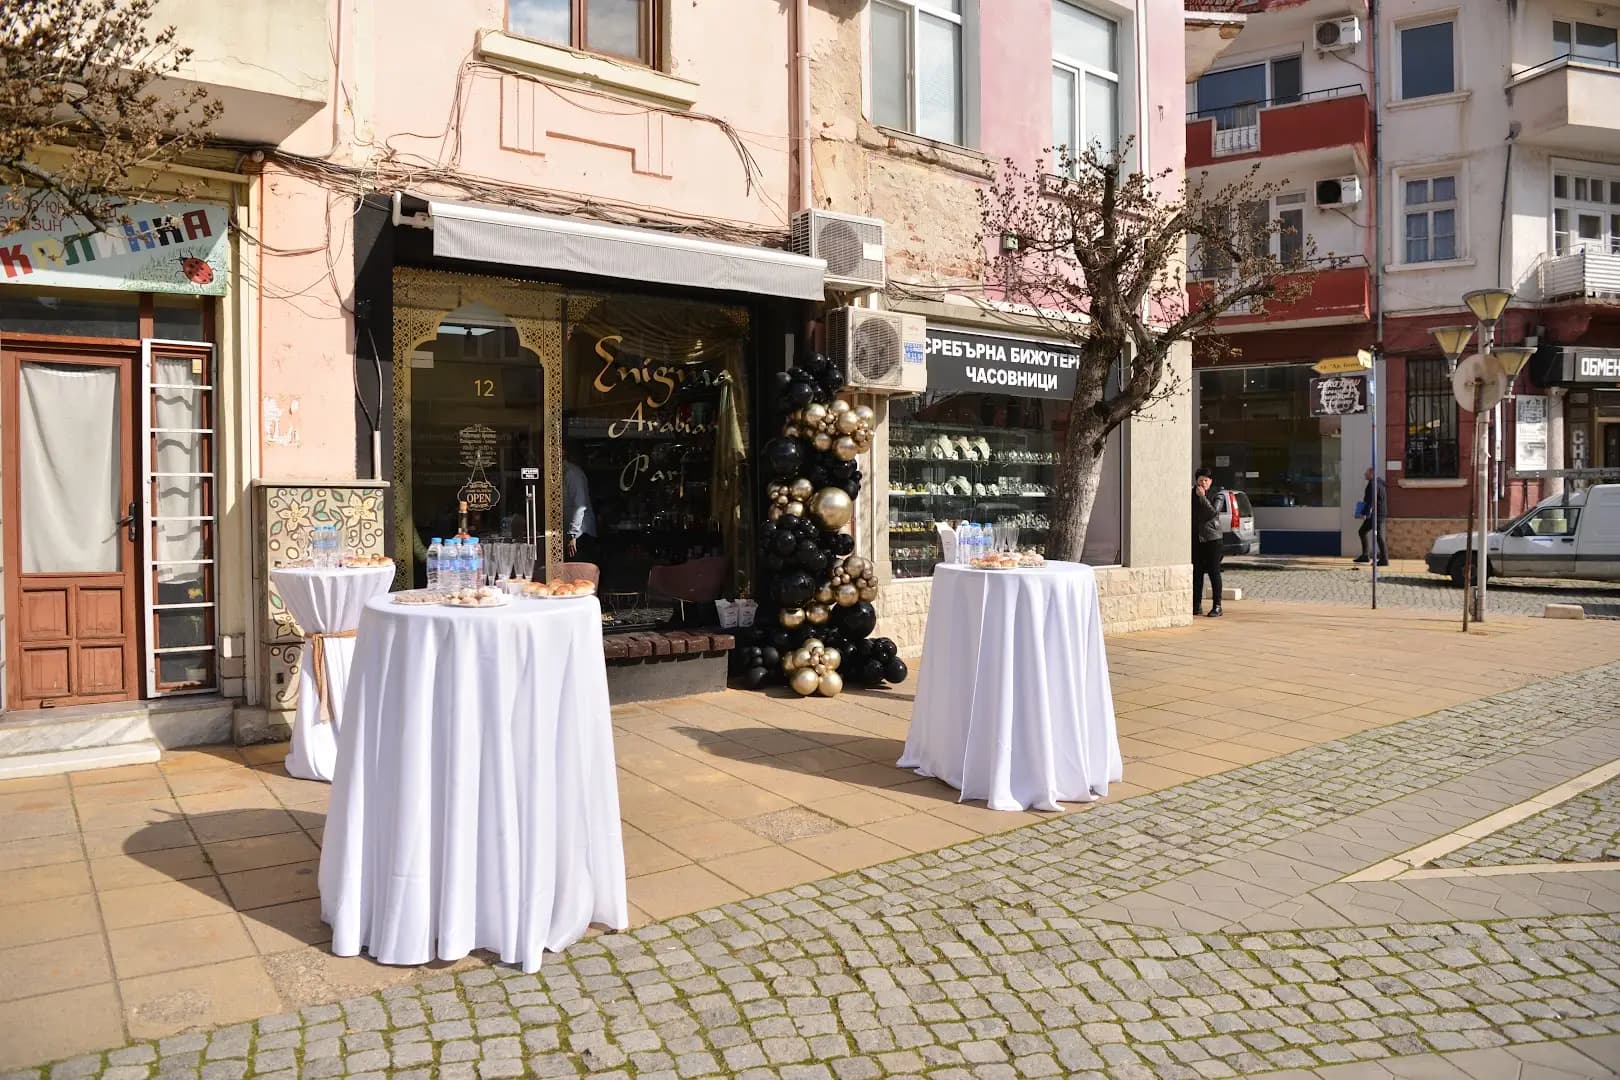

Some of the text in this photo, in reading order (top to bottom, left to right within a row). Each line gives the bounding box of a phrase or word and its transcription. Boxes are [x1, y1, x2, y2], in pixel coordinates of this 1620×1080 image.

[925, 337, 1006, 362] СРЕБЪРНА
[474, 379, 495, 397] 12
[966, 366, 1058, 391] ЧАСОВНИЦИ
[466, 493, 492, 504] OPEN
